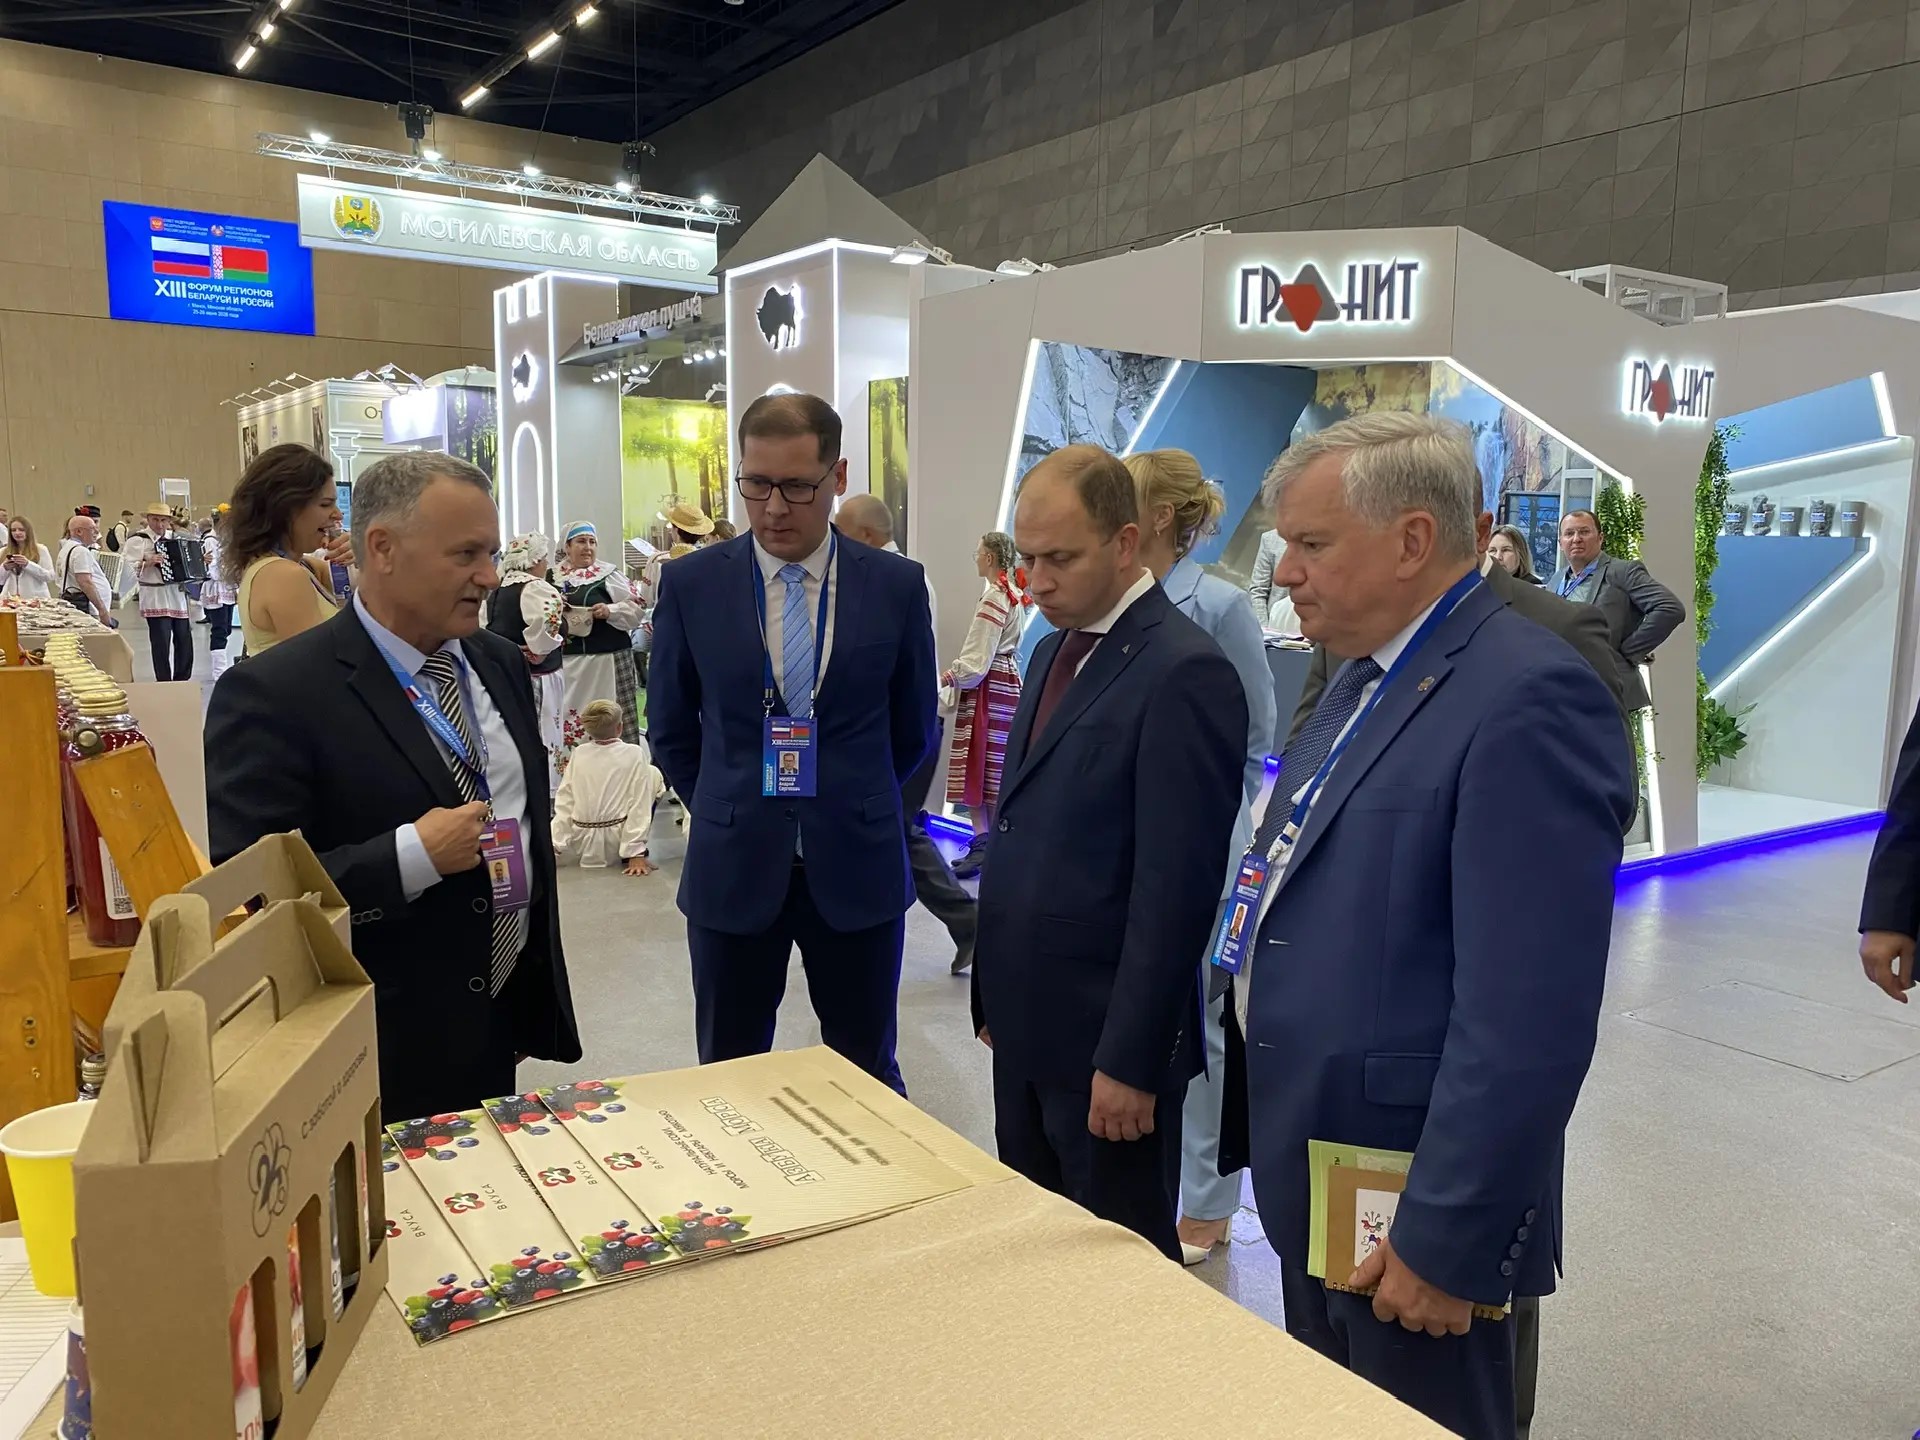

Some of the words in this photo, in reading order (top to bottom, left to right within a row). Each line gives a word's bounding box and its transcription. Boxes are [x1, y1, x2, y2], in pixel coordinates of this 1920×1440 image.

[400, 211, 592, 258] МОГИЛЕВСКАЯ
[597, 238, 700, 271] ОБЛАСТЬ
[154, 279, 187, 299] XIII
[187, 282, 222, 293] ФОРУМ
[223, 285, 274, 298] РЕГИОНОВ
[187, 292, 232, 304] БЕЛАРУСИ
[233, 296, 240, 305] И
[241, 296, 275, 309] РОССИИ
[417, 699, 437, 720] XIII
[636, 1144, 665, 1170] ВКУСА
[750, 1137, 824, 1185] АЗБУКА
[573, 1160, 598, 1185] ВКУСА
[480, 1183, 508, 1211] ВКУСА
[400, 1209, 426, 1238] ВКУСА
